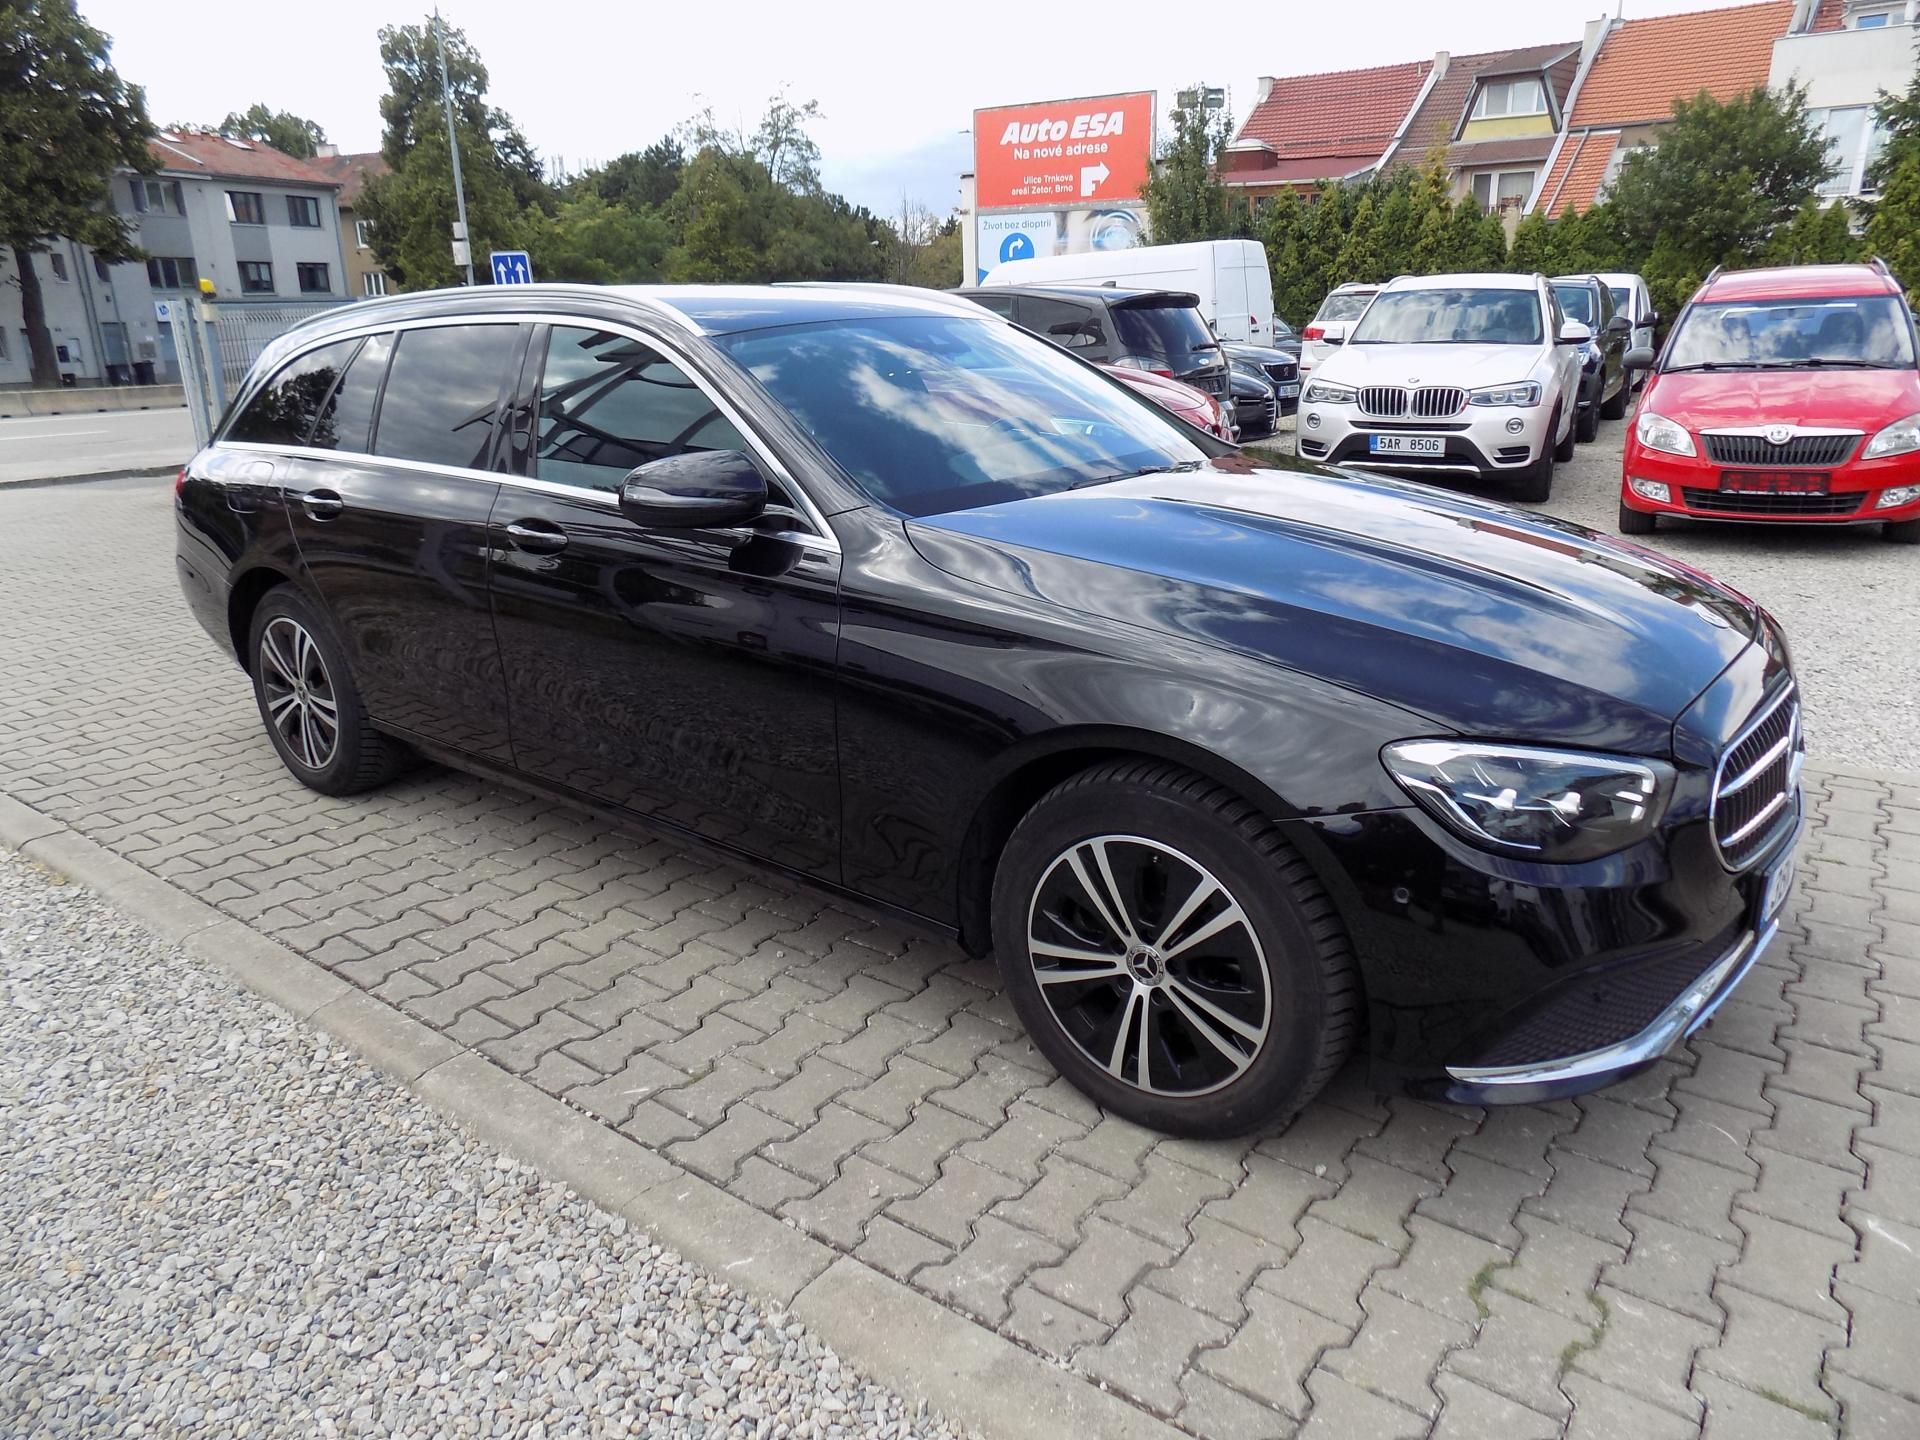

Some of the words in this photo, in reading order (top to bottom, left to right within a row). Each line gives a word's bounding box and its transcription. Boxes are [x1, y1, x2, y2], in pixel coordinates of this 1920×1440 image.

[1000, 118, 1068, 145] Auto
[1070, 111, 1124, 139] ESA
[1013, 148, 1030, 160] Na
[1033, 146, 1063, 158] nové
[1066, 141, 1108, 155] adrese
[1023, 175, 1042, 185] Ulice
[1044, 173, 1073, 183] Trnkova
[1031, 185, 1053, 195] Zetor,
[1055, 184, 1073, 193] Brno
[983, 220, 1003, 231] Život
[1004, 220, 1020, 229] bez
[1380, 438, 1400, 449] 5AR
[1410, 439, 1439, 451] 8506
